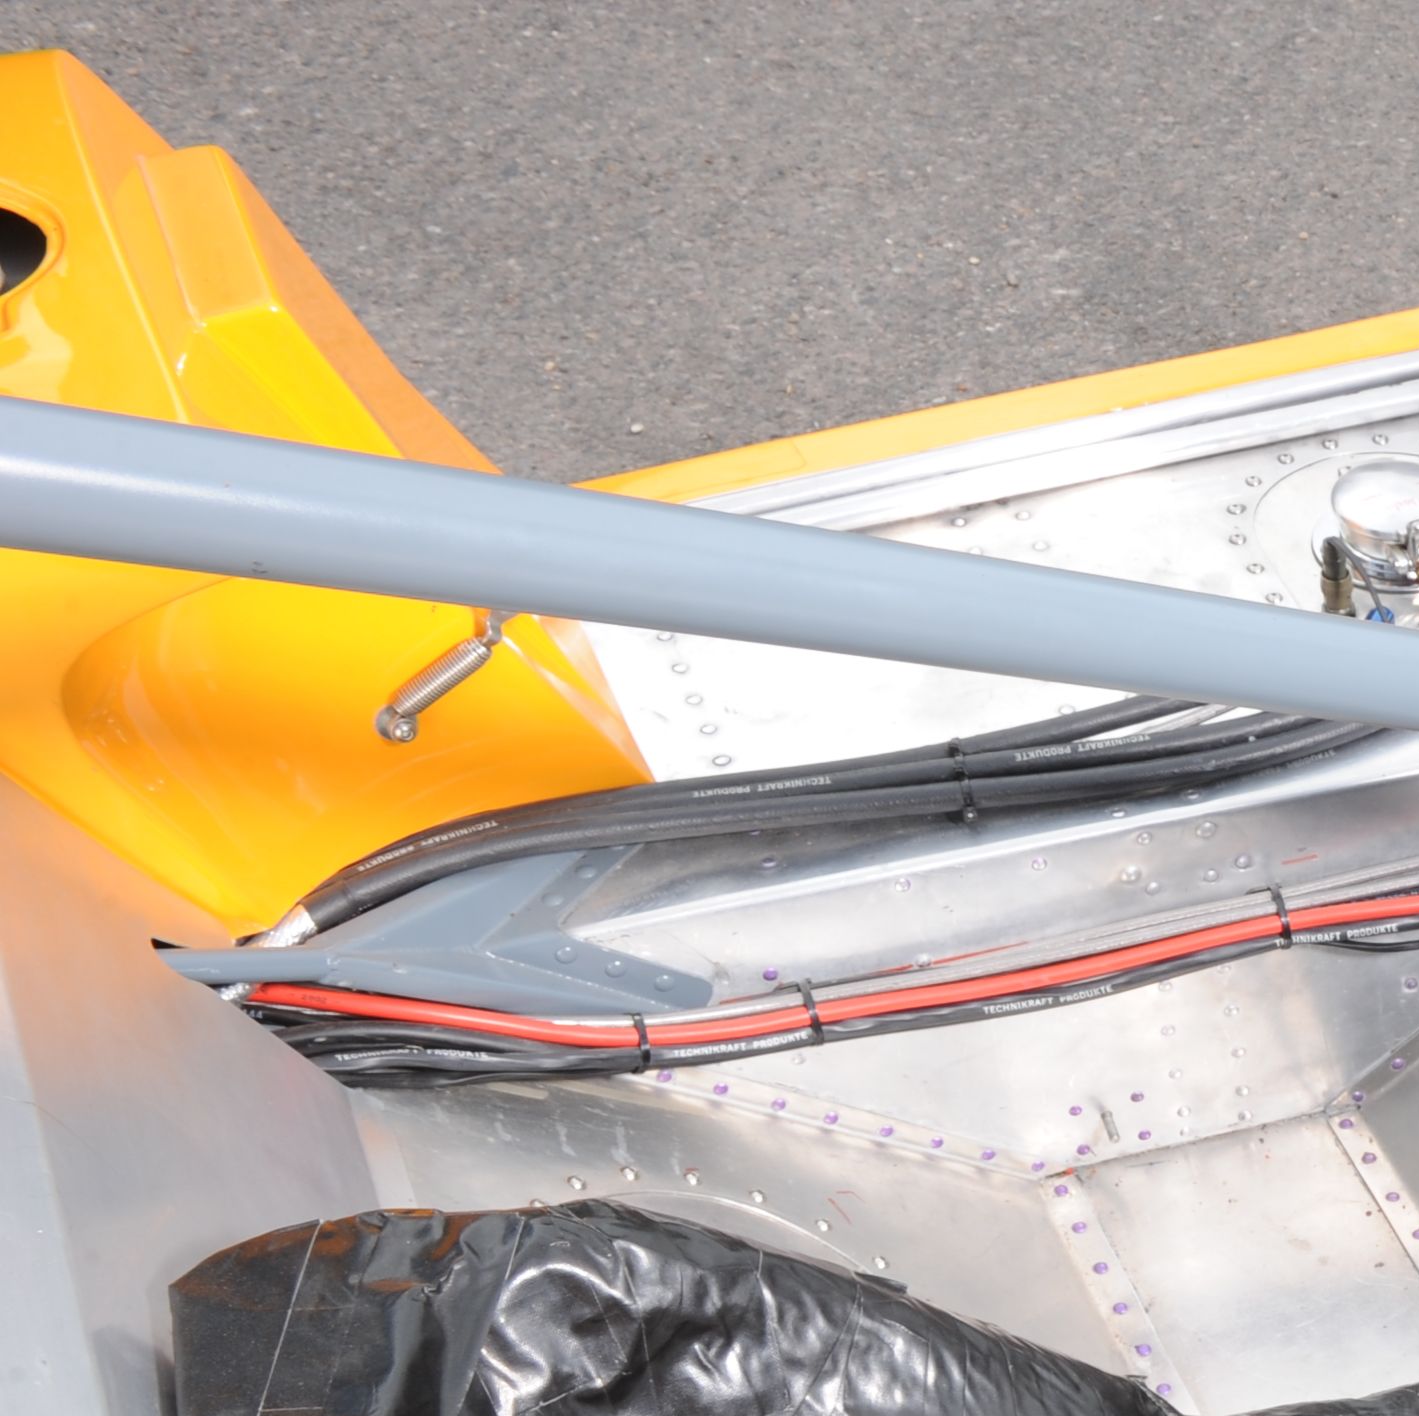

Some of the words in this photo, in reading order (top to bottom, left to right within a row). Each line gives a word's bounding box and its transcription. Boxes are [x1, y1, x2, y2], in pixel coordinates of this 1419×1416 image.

[1015, 746, 1071, 761] PRODUKTE
[693, 785, 750, 798] PRODUKTE
[757, 776, 831, 792] TECHNIKRAFT
[1347, 924, 1398, 939] PRODUKTE
[983, 997, 1054, 1014] TECHNIKRAFT
[1059, 984, 1113, 1002] PRODUKTE
[674, 1042, 747, 1057] TECHNIKRAFT
[753, 1031, 808, 1050] PRODUKTE
